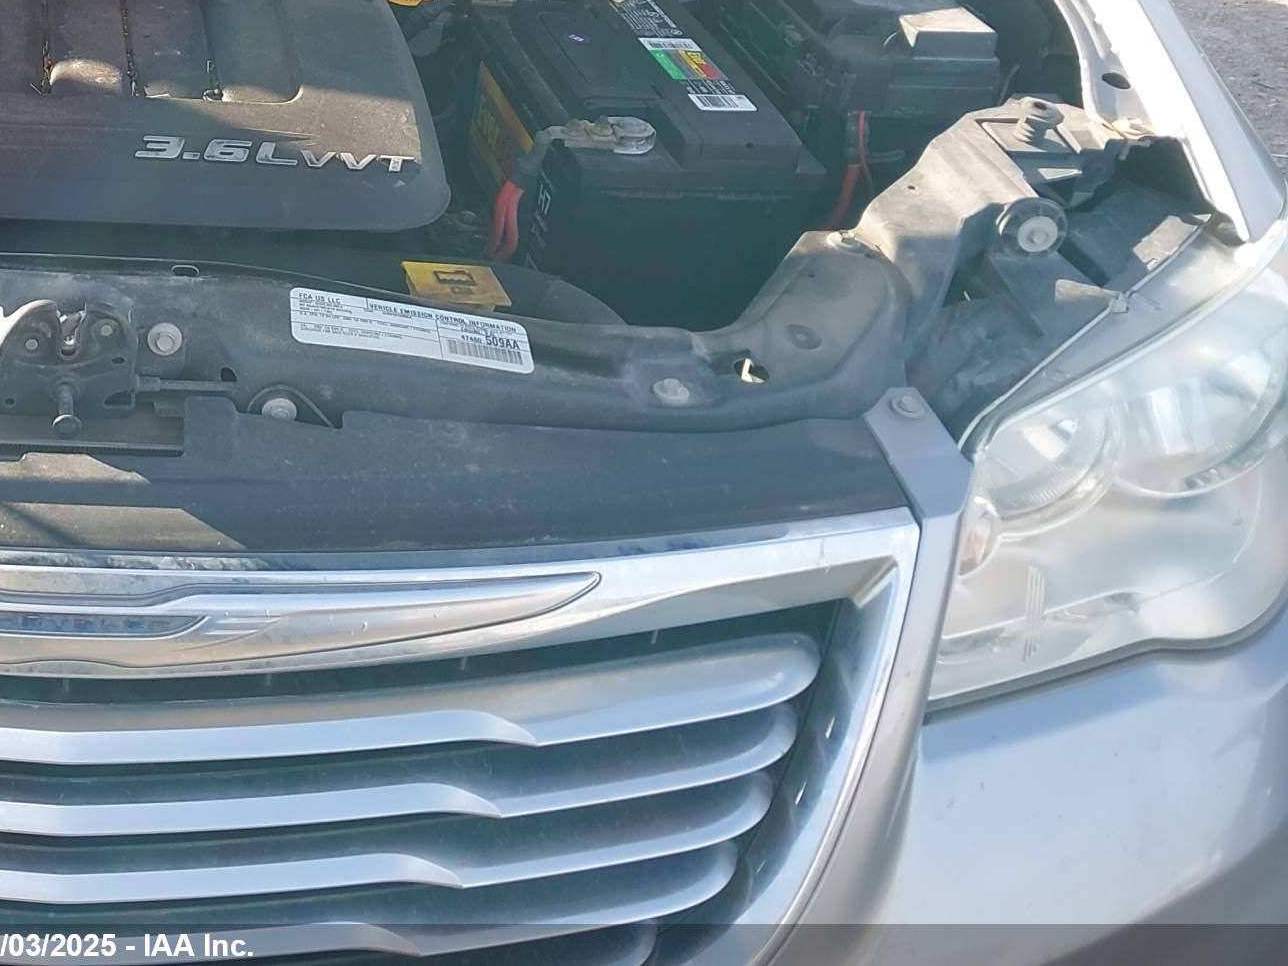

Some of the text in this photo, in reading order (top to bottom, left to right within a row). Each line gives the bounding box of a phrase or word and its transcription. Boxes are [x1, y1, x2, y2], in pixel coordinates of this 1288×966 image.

[370, 304, 396, 314] VEHICLE
[400, 308, 433, 320] EMISSION
[435, 314, 465, 326] CONTROL
[469, 320, 516, 333] INFORMATION
